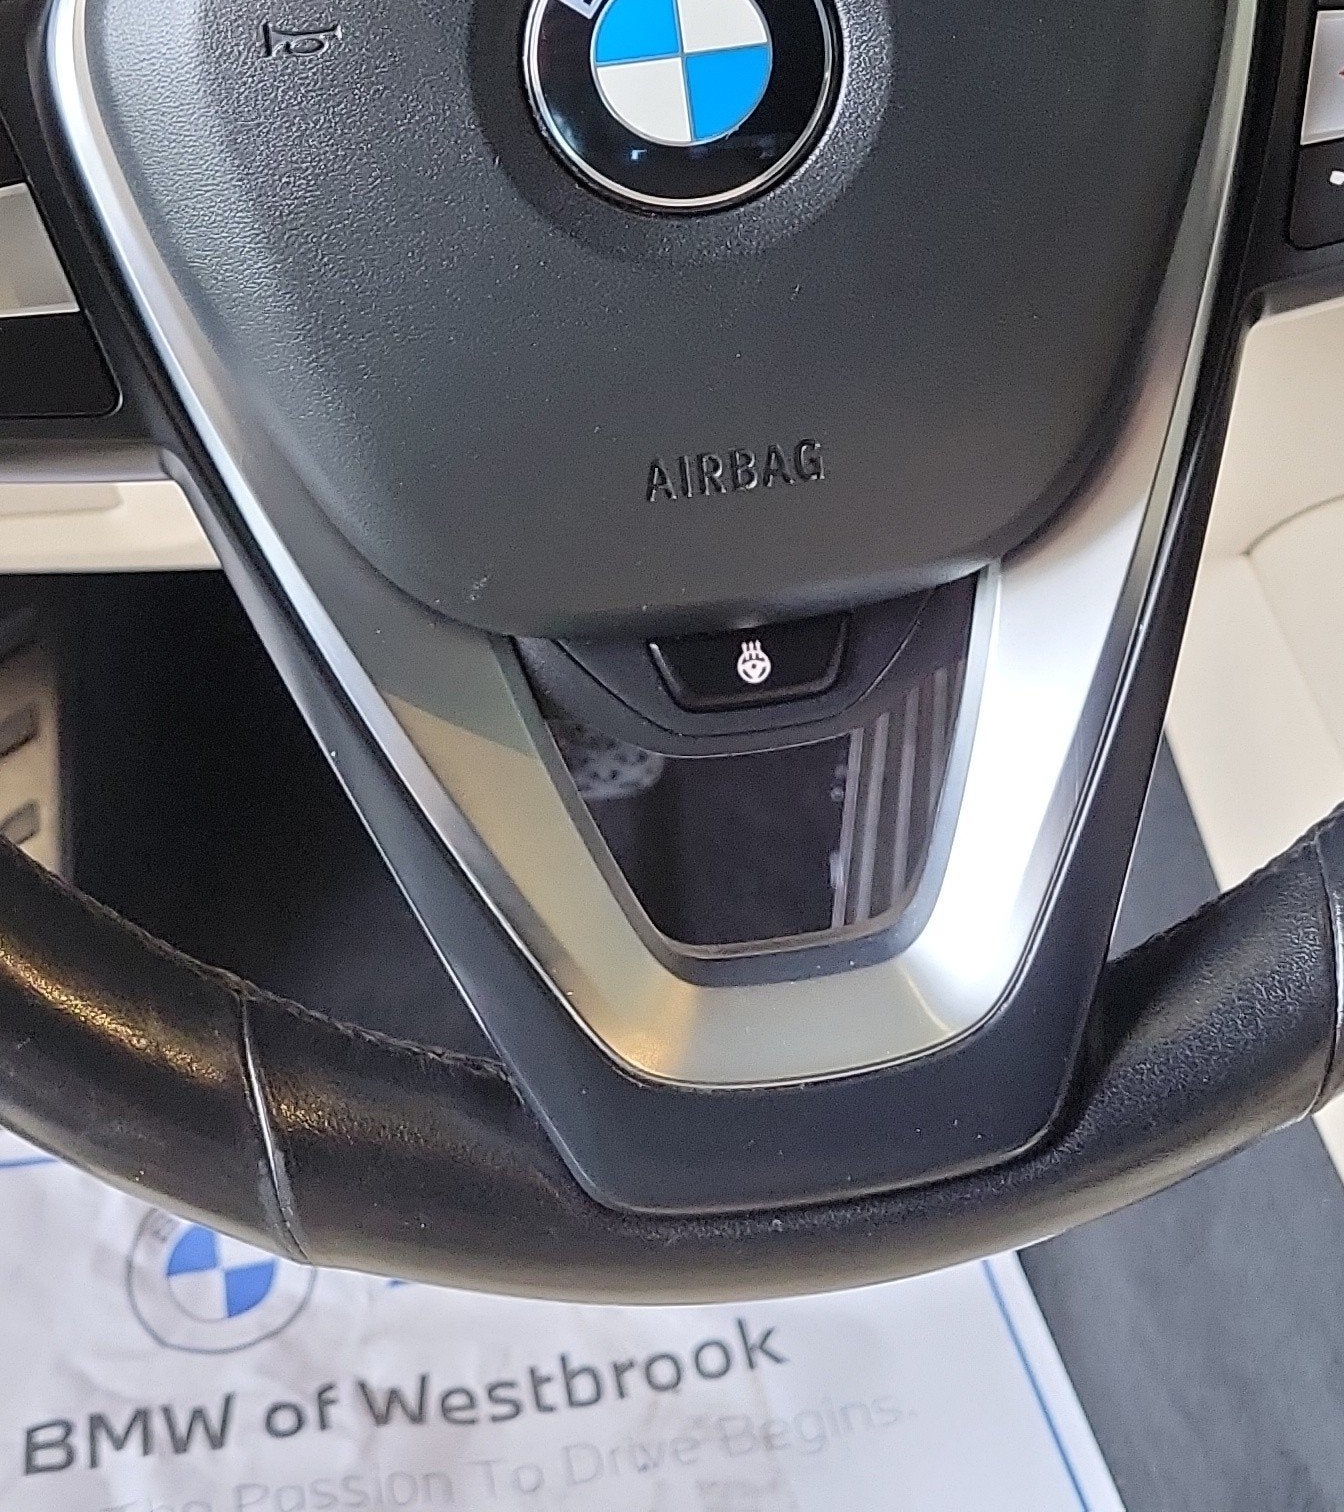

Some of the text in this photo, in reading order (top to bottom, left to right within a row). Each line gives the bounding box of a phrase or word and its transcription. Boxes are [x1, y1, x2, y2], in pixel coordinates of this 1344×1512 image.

[645, 437, 827, 502] AIRBAG
[22, 1317, 788, 1477] BMW of Westbrook
[230, 1469, 456, 1512] Passion
[467, 1455, 545, 1500] To
[561, 1431, 702, 1487] Drive
